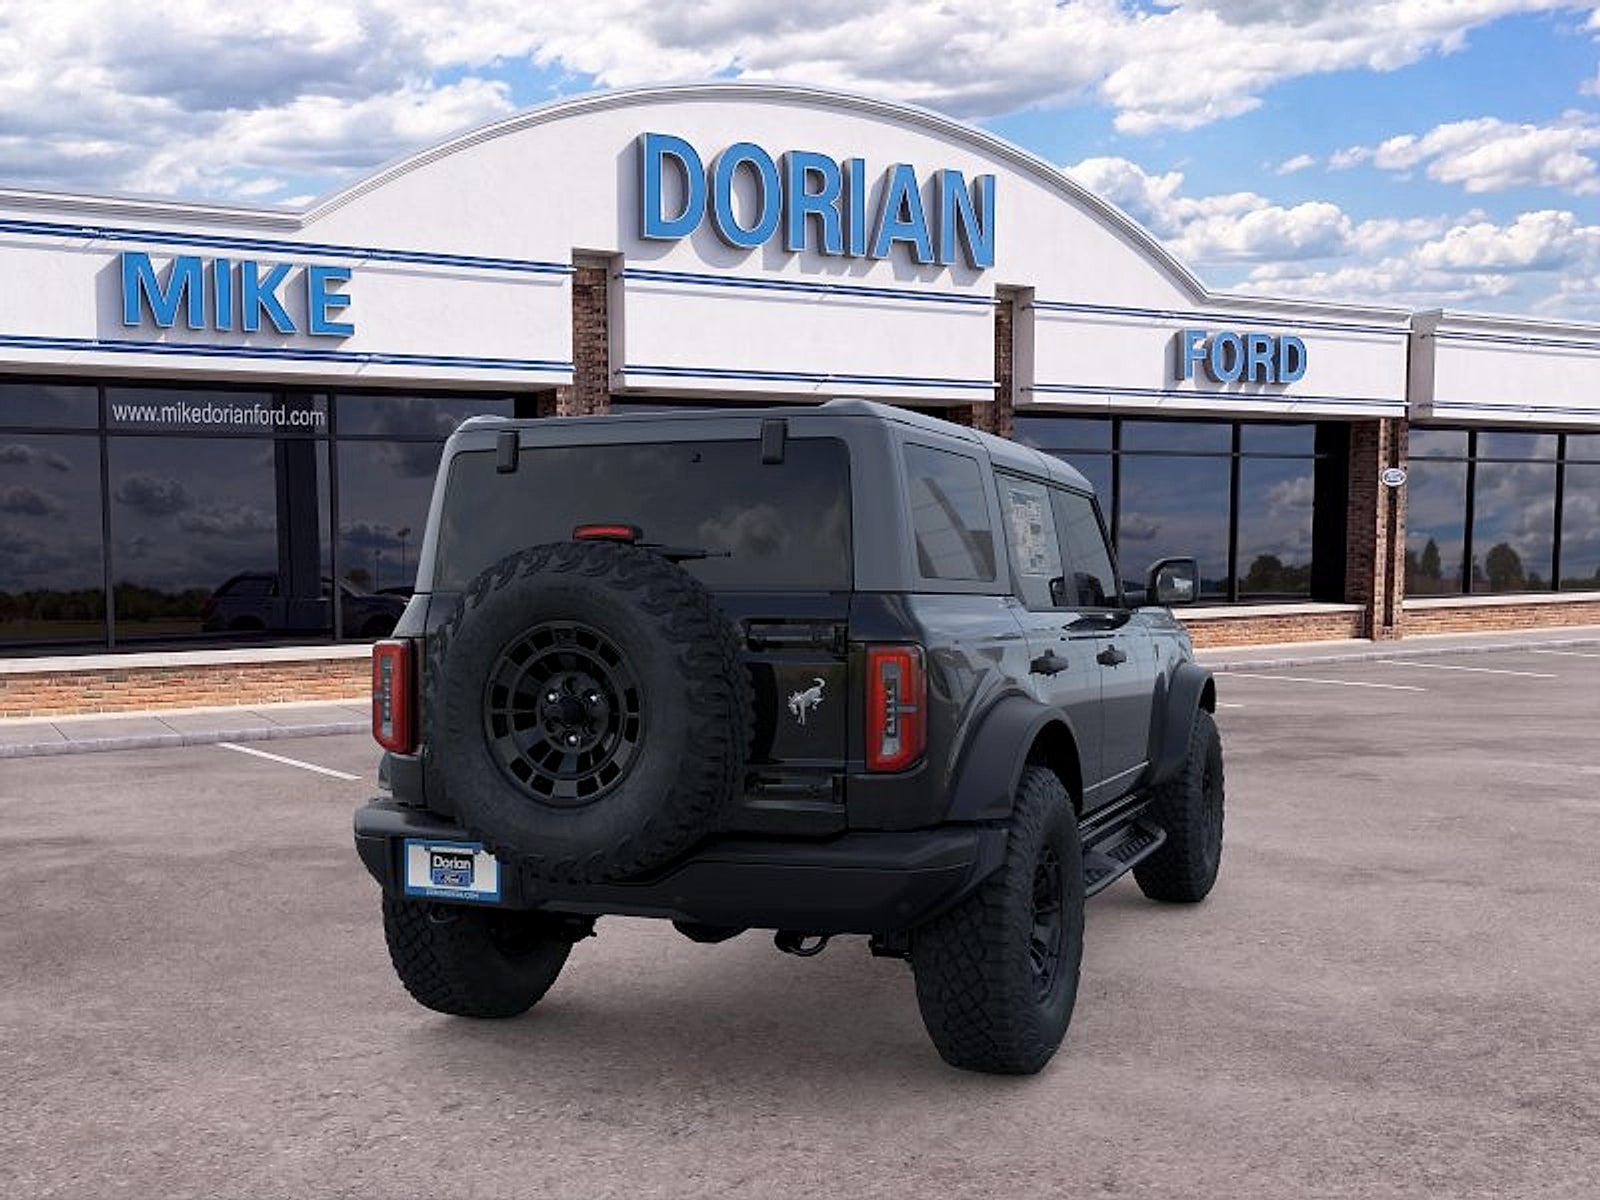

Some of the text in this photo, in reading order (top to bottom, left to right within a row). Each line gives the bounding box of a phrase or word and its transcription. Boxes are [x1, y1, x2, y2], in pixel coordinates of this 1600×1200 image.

[641, 131, 995, 269] DORIAN
[122, 251, 354, 336] MIKE
[1179, 328, 1307, 384] FORD
[112, 402, 325, 426] www.mikedorianford.com
[433, 855, 471, 869] Dorian
